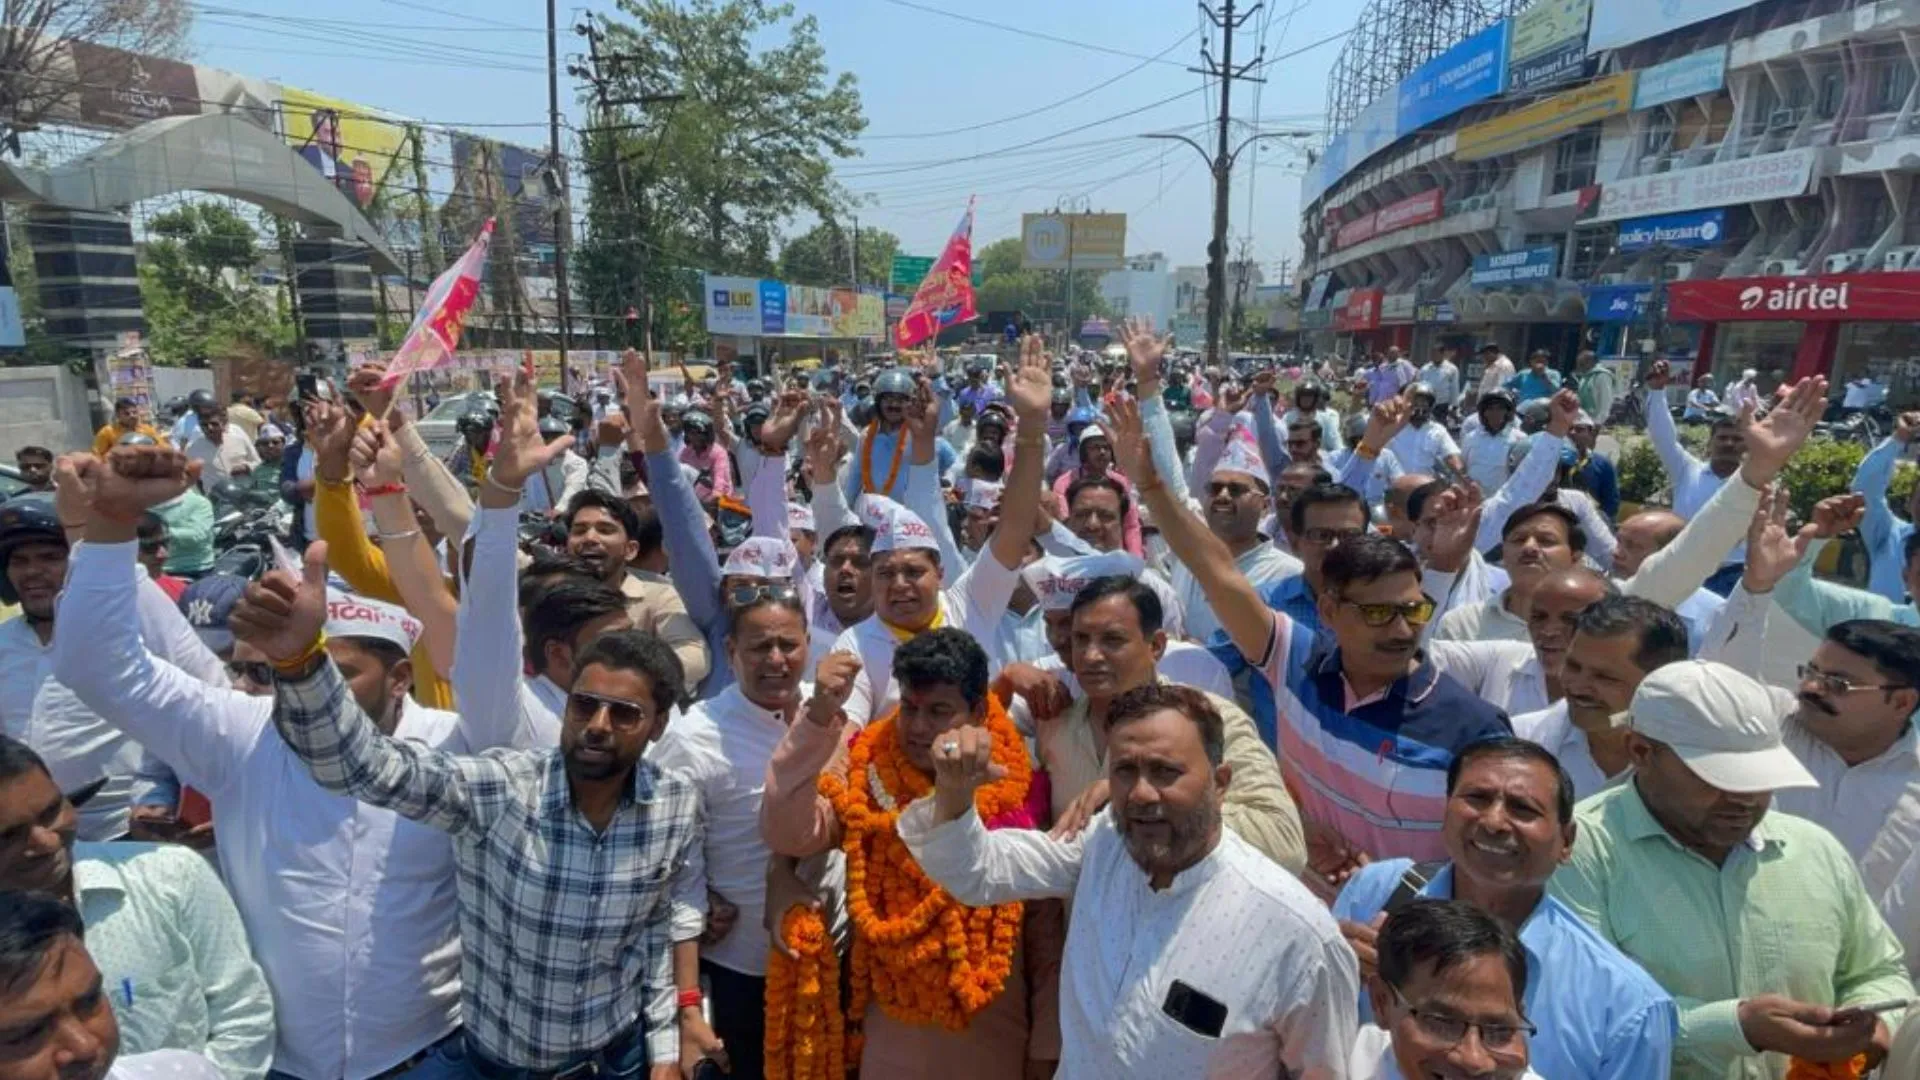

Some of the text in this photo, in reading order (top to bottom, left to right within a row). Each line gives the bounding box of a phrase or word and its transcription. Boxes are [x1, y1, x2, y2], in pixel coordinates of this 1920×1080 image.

[1602, 178, 1681, 201] O-LET
[1619, 225, 1700, 247] policybazaar
[1767, 281, 1848, 311] airtel
